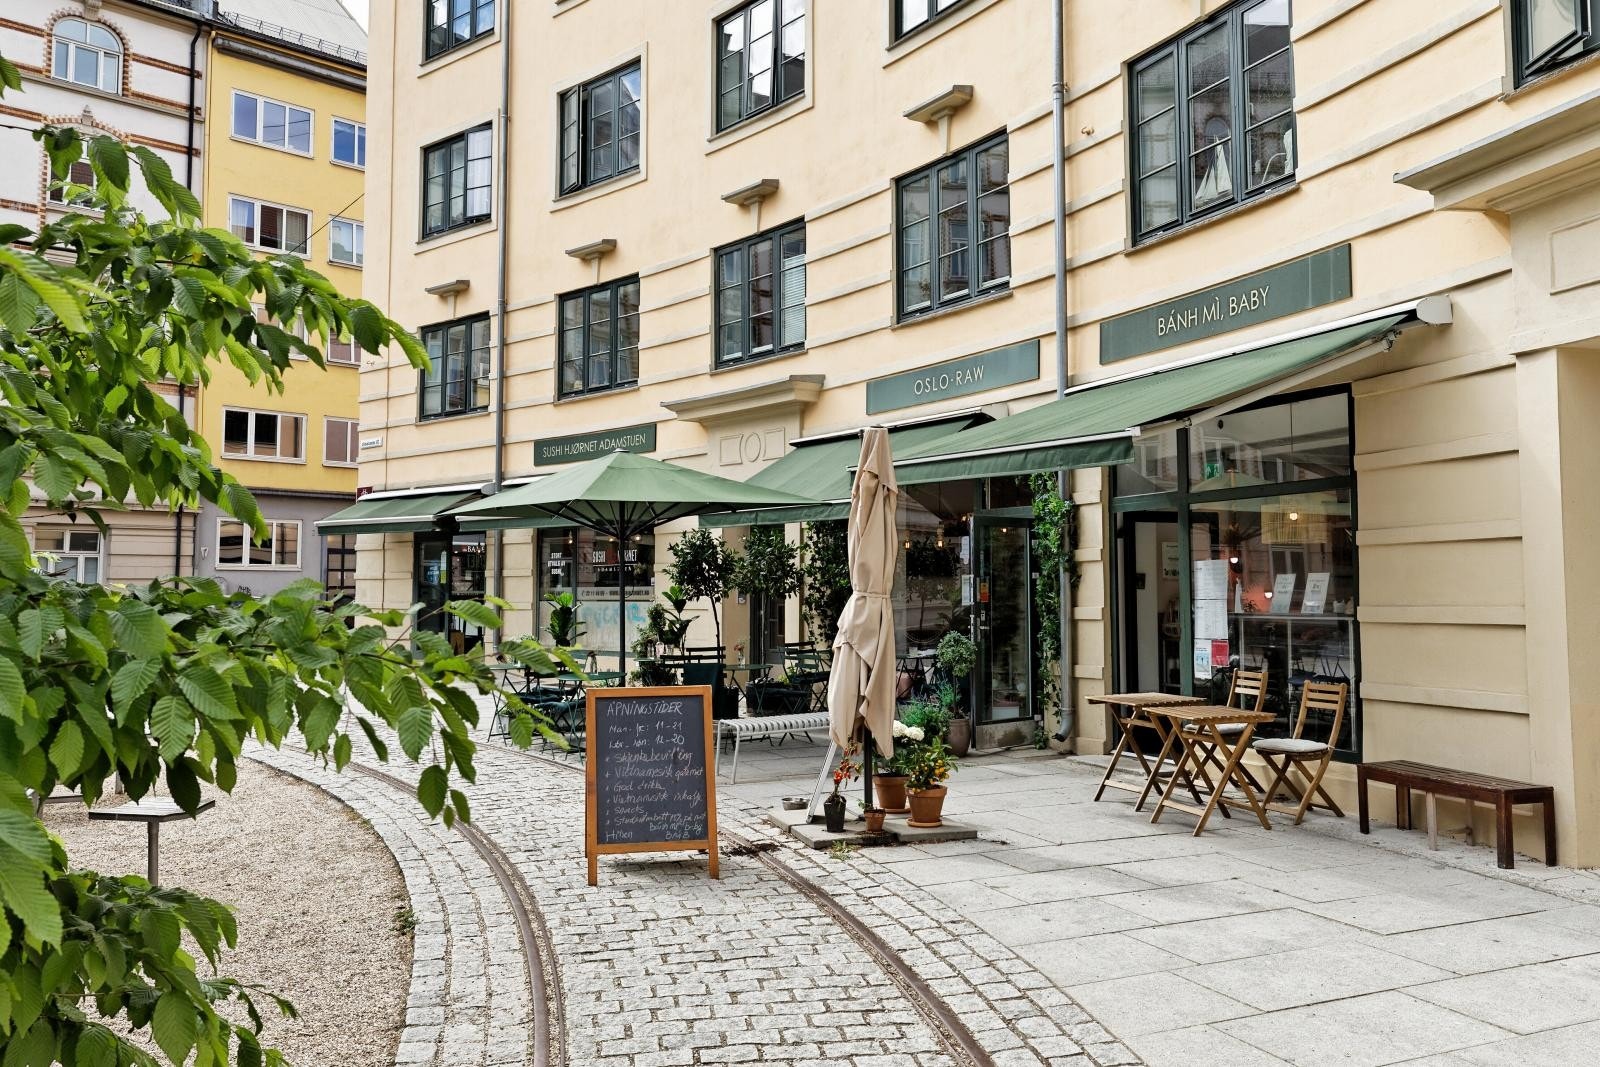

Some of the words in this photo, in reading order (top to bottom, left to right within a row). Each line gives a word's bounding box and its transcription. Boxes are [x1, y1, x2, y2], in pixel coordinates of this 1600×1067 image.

[1158, 307, 1198, 336] BÁNH
[1203, 297, 1224, 324] MÌ,
[1229, 286, 1270, 316] BABY
[543, 445, 563, 458] SUSHI
[564, 440, 598, 455] HJØRNET
[599, 433, 646, 450] ADAMSTUEN
[593, 551, 606, 563] SUSHI
